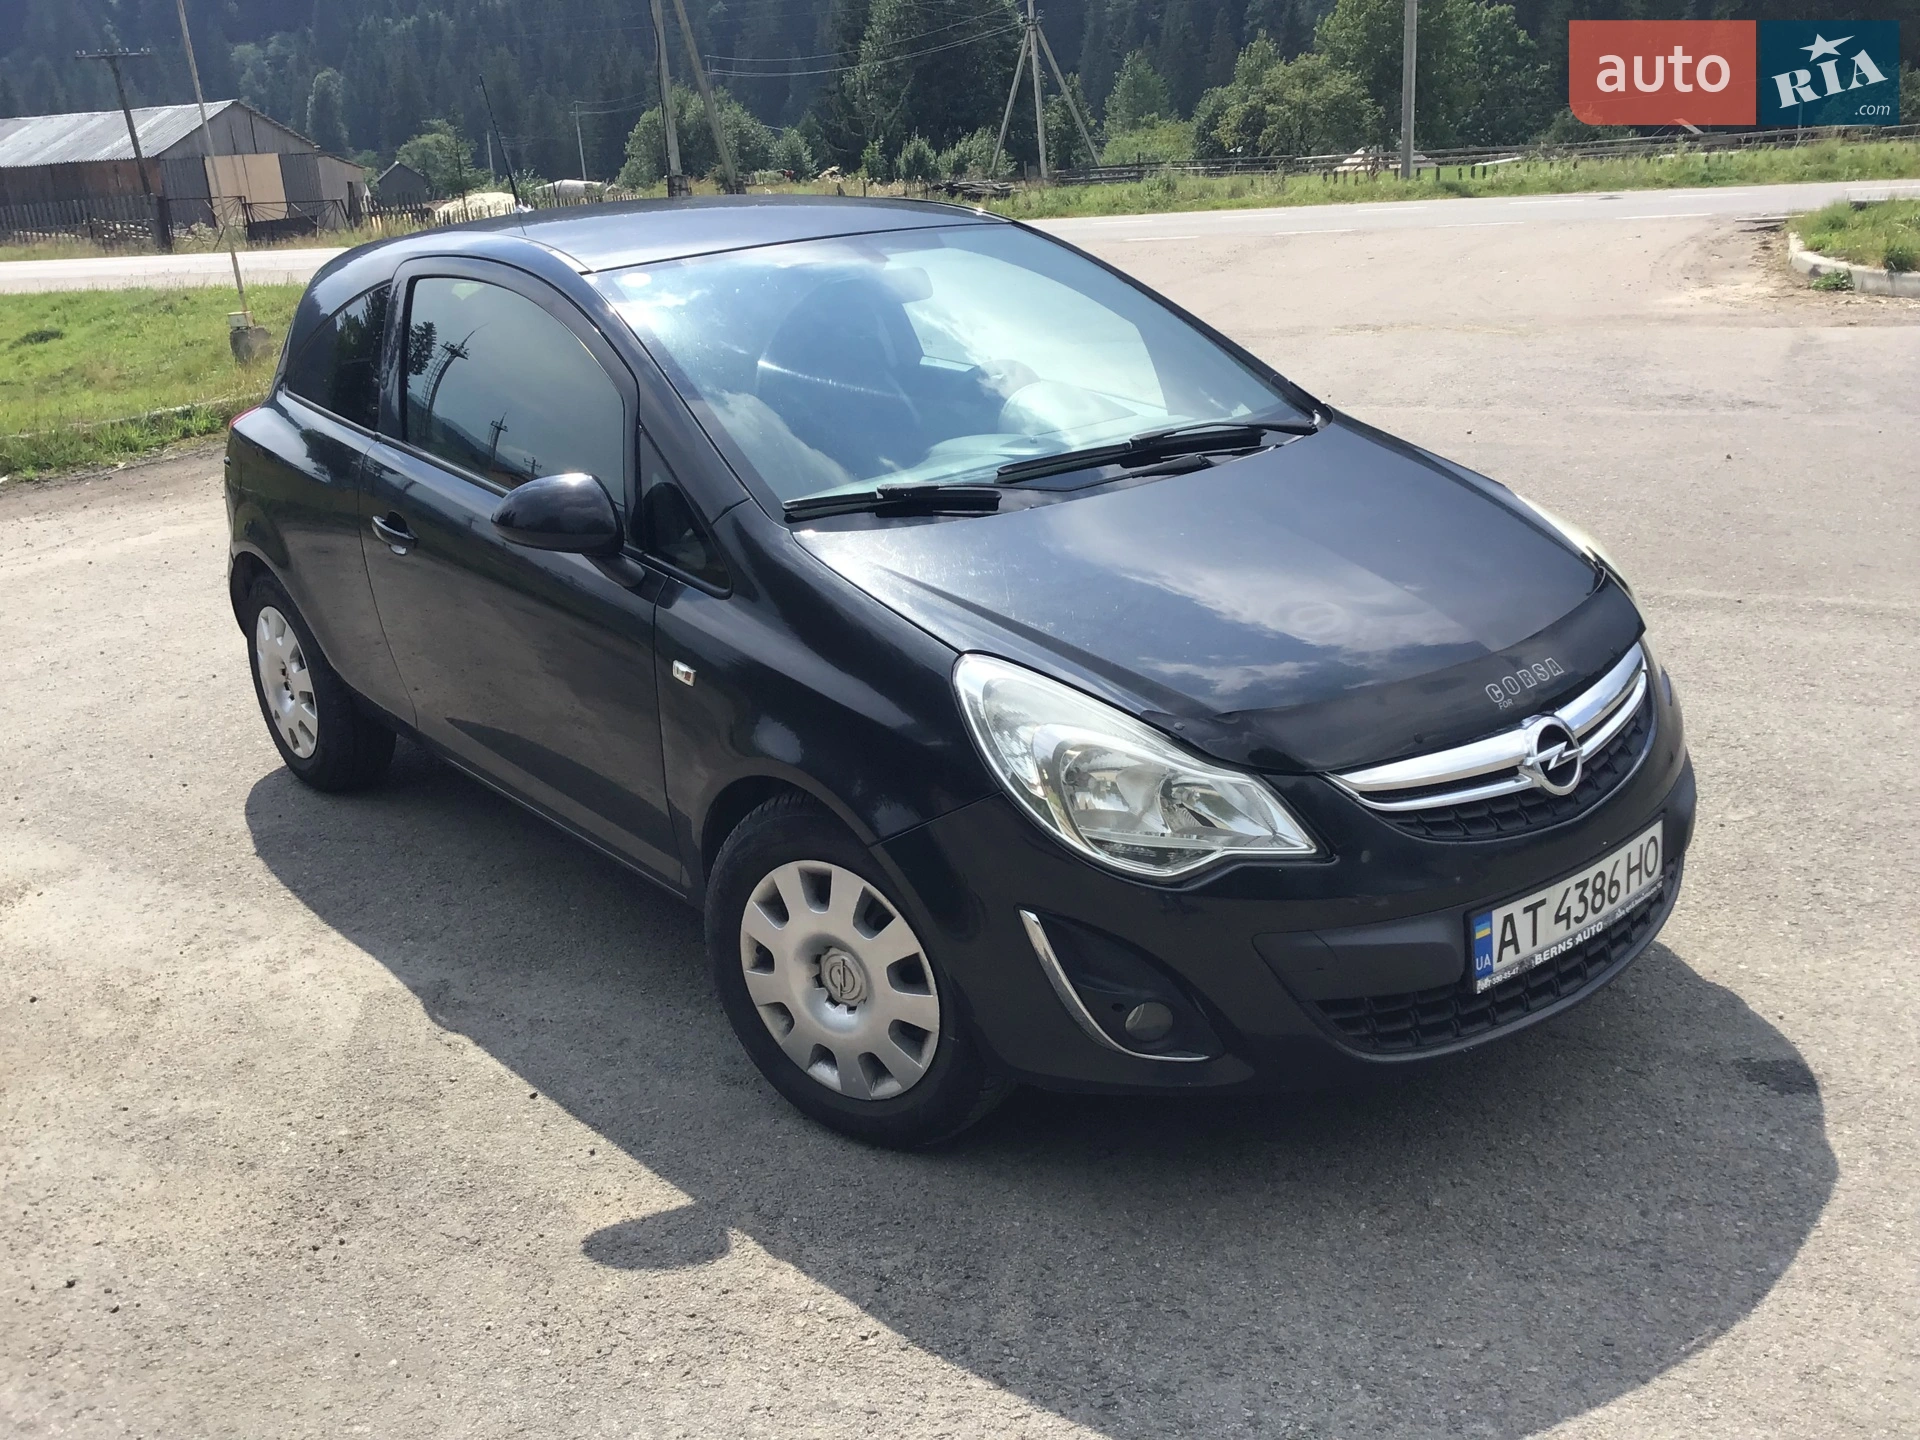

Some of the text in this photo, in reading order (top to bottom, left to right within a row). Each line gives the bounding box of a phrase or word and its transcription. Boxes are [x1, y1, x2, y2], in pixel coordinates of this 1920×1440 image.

[1485, 657, 1565, 703] CORSA
[1498, 698, 1514, 710] FOR
[1496, 897, 1547, 963] AT
[1553, 858, 1622, 931] 4386
[1625, 835, 1659, 895] HO
[1475, 953, 1492, 971] UA
[1533, 921, 1604, 966] BERNS AUTO
